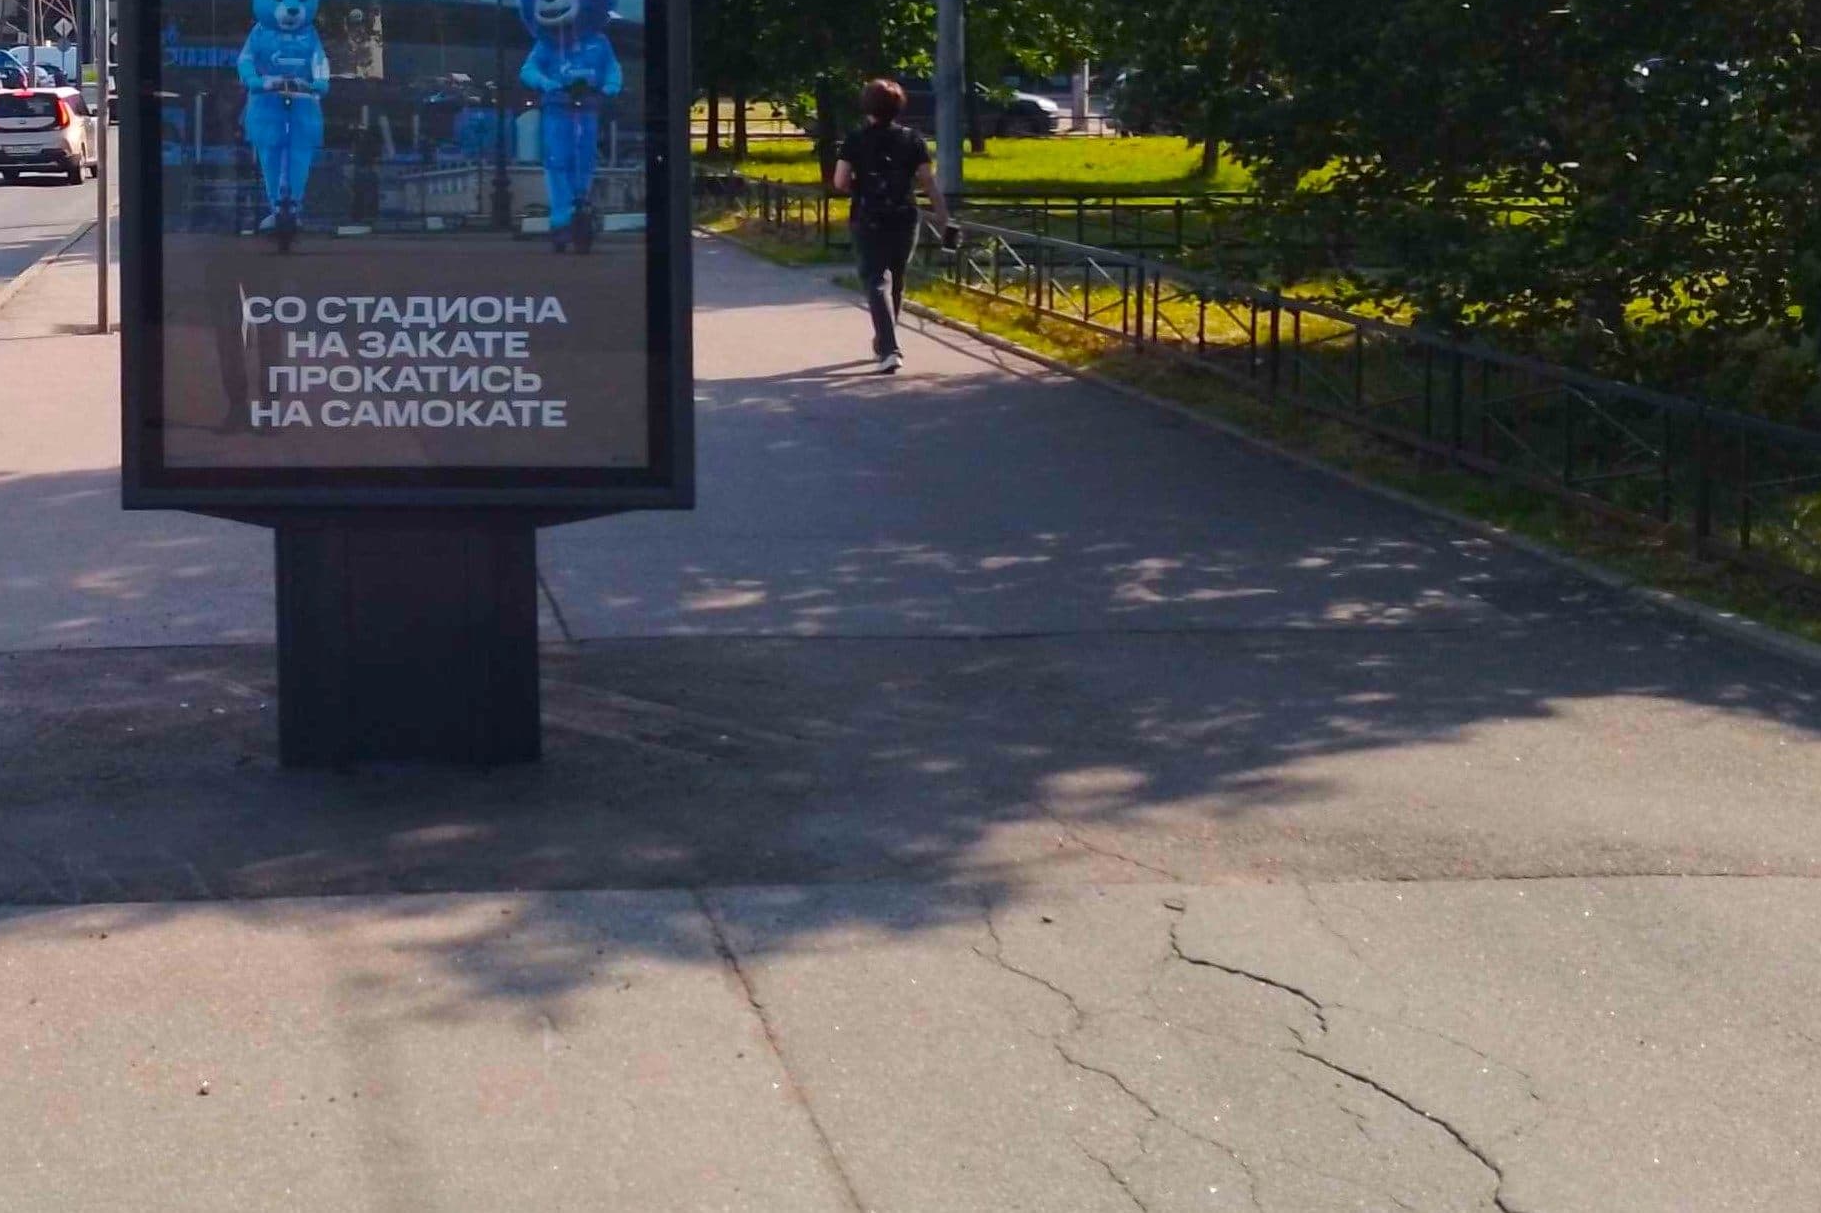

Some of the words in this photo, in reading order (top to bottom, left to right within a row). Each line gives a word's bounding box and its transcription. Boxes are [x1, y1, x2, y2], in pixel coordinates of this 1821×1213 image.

[246, 296, 307, 324] СО
[316, 296, 567, 329] СТАДИОНА
[287, 331, 350, 358] НА
[358, 331, 530, 359] ЗАКАТЕ
[268, 365, 542, 393] ПРОКАТИСЬ
[250, 400, 313, 427] НА
[320, 399, 568, 428] САМОКАТЕ
